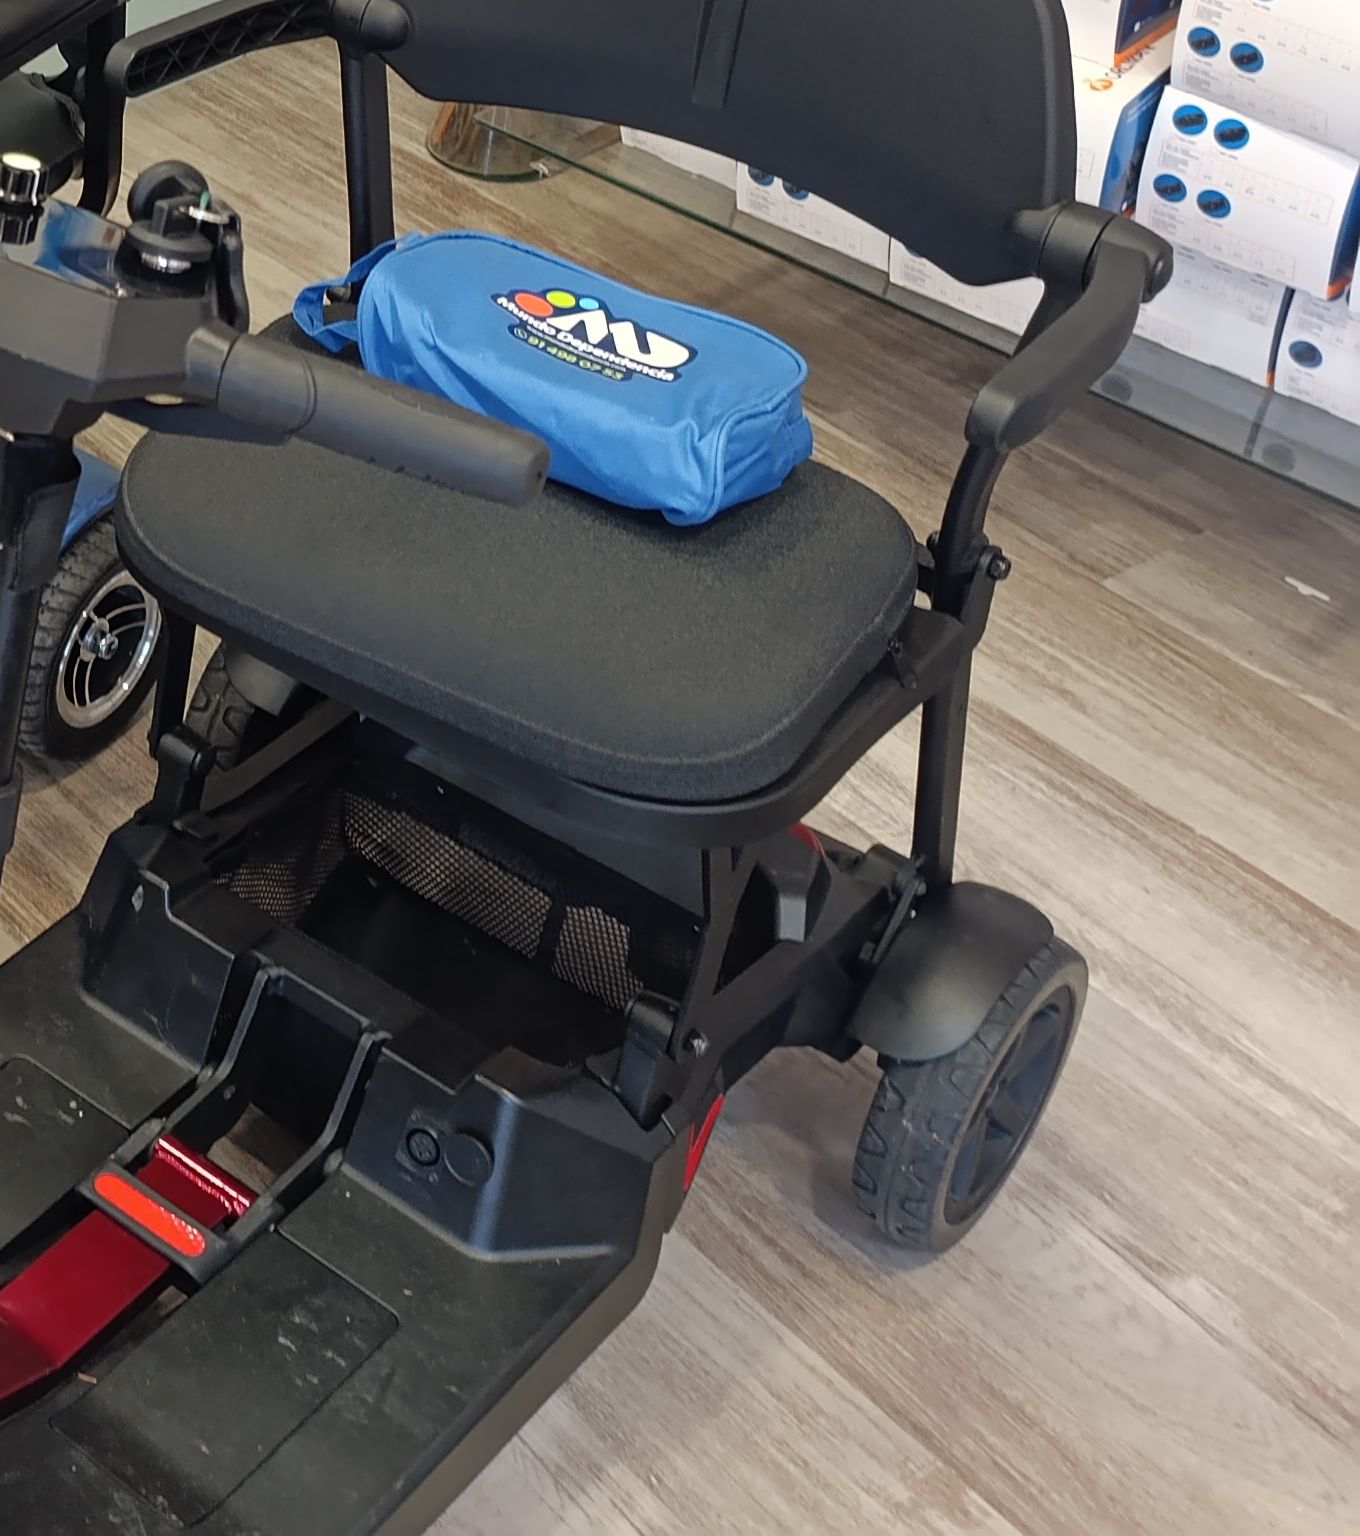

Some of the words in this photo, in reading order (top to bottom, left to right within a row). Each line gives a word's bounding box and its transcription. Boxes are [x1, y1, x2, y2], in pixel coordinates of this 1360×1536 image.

[496, 295, 558, 337] Mundo
[555, 329, 676, 383] Dependencia
[526, 334, 546, 350] 91
[546, 344, 578, 366] 498
[578, 357, 602, 374] 07
[601, 366, 625, 382] 53
